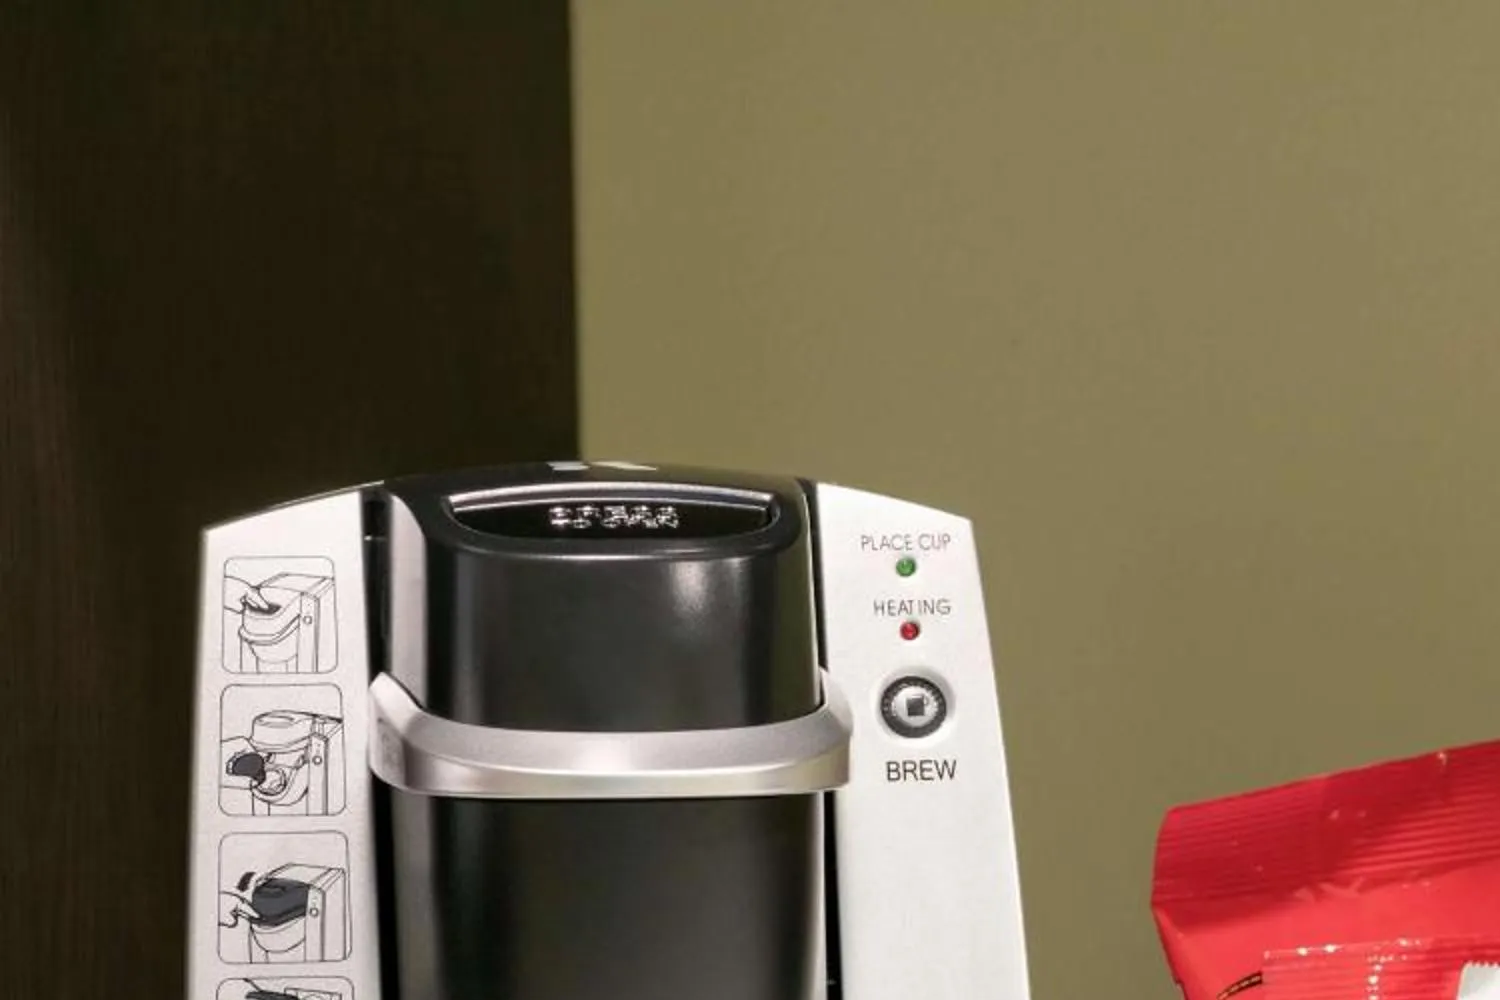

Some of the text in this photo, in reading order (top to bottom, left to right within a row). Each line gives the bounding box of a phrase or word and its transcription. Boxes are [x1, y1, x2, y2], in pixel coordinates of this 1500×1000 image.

[860, 533, 951, 551] PLACE CUP
[873, 598, 951, 616] HEATING
[886, 760, 957, 782] BREW
